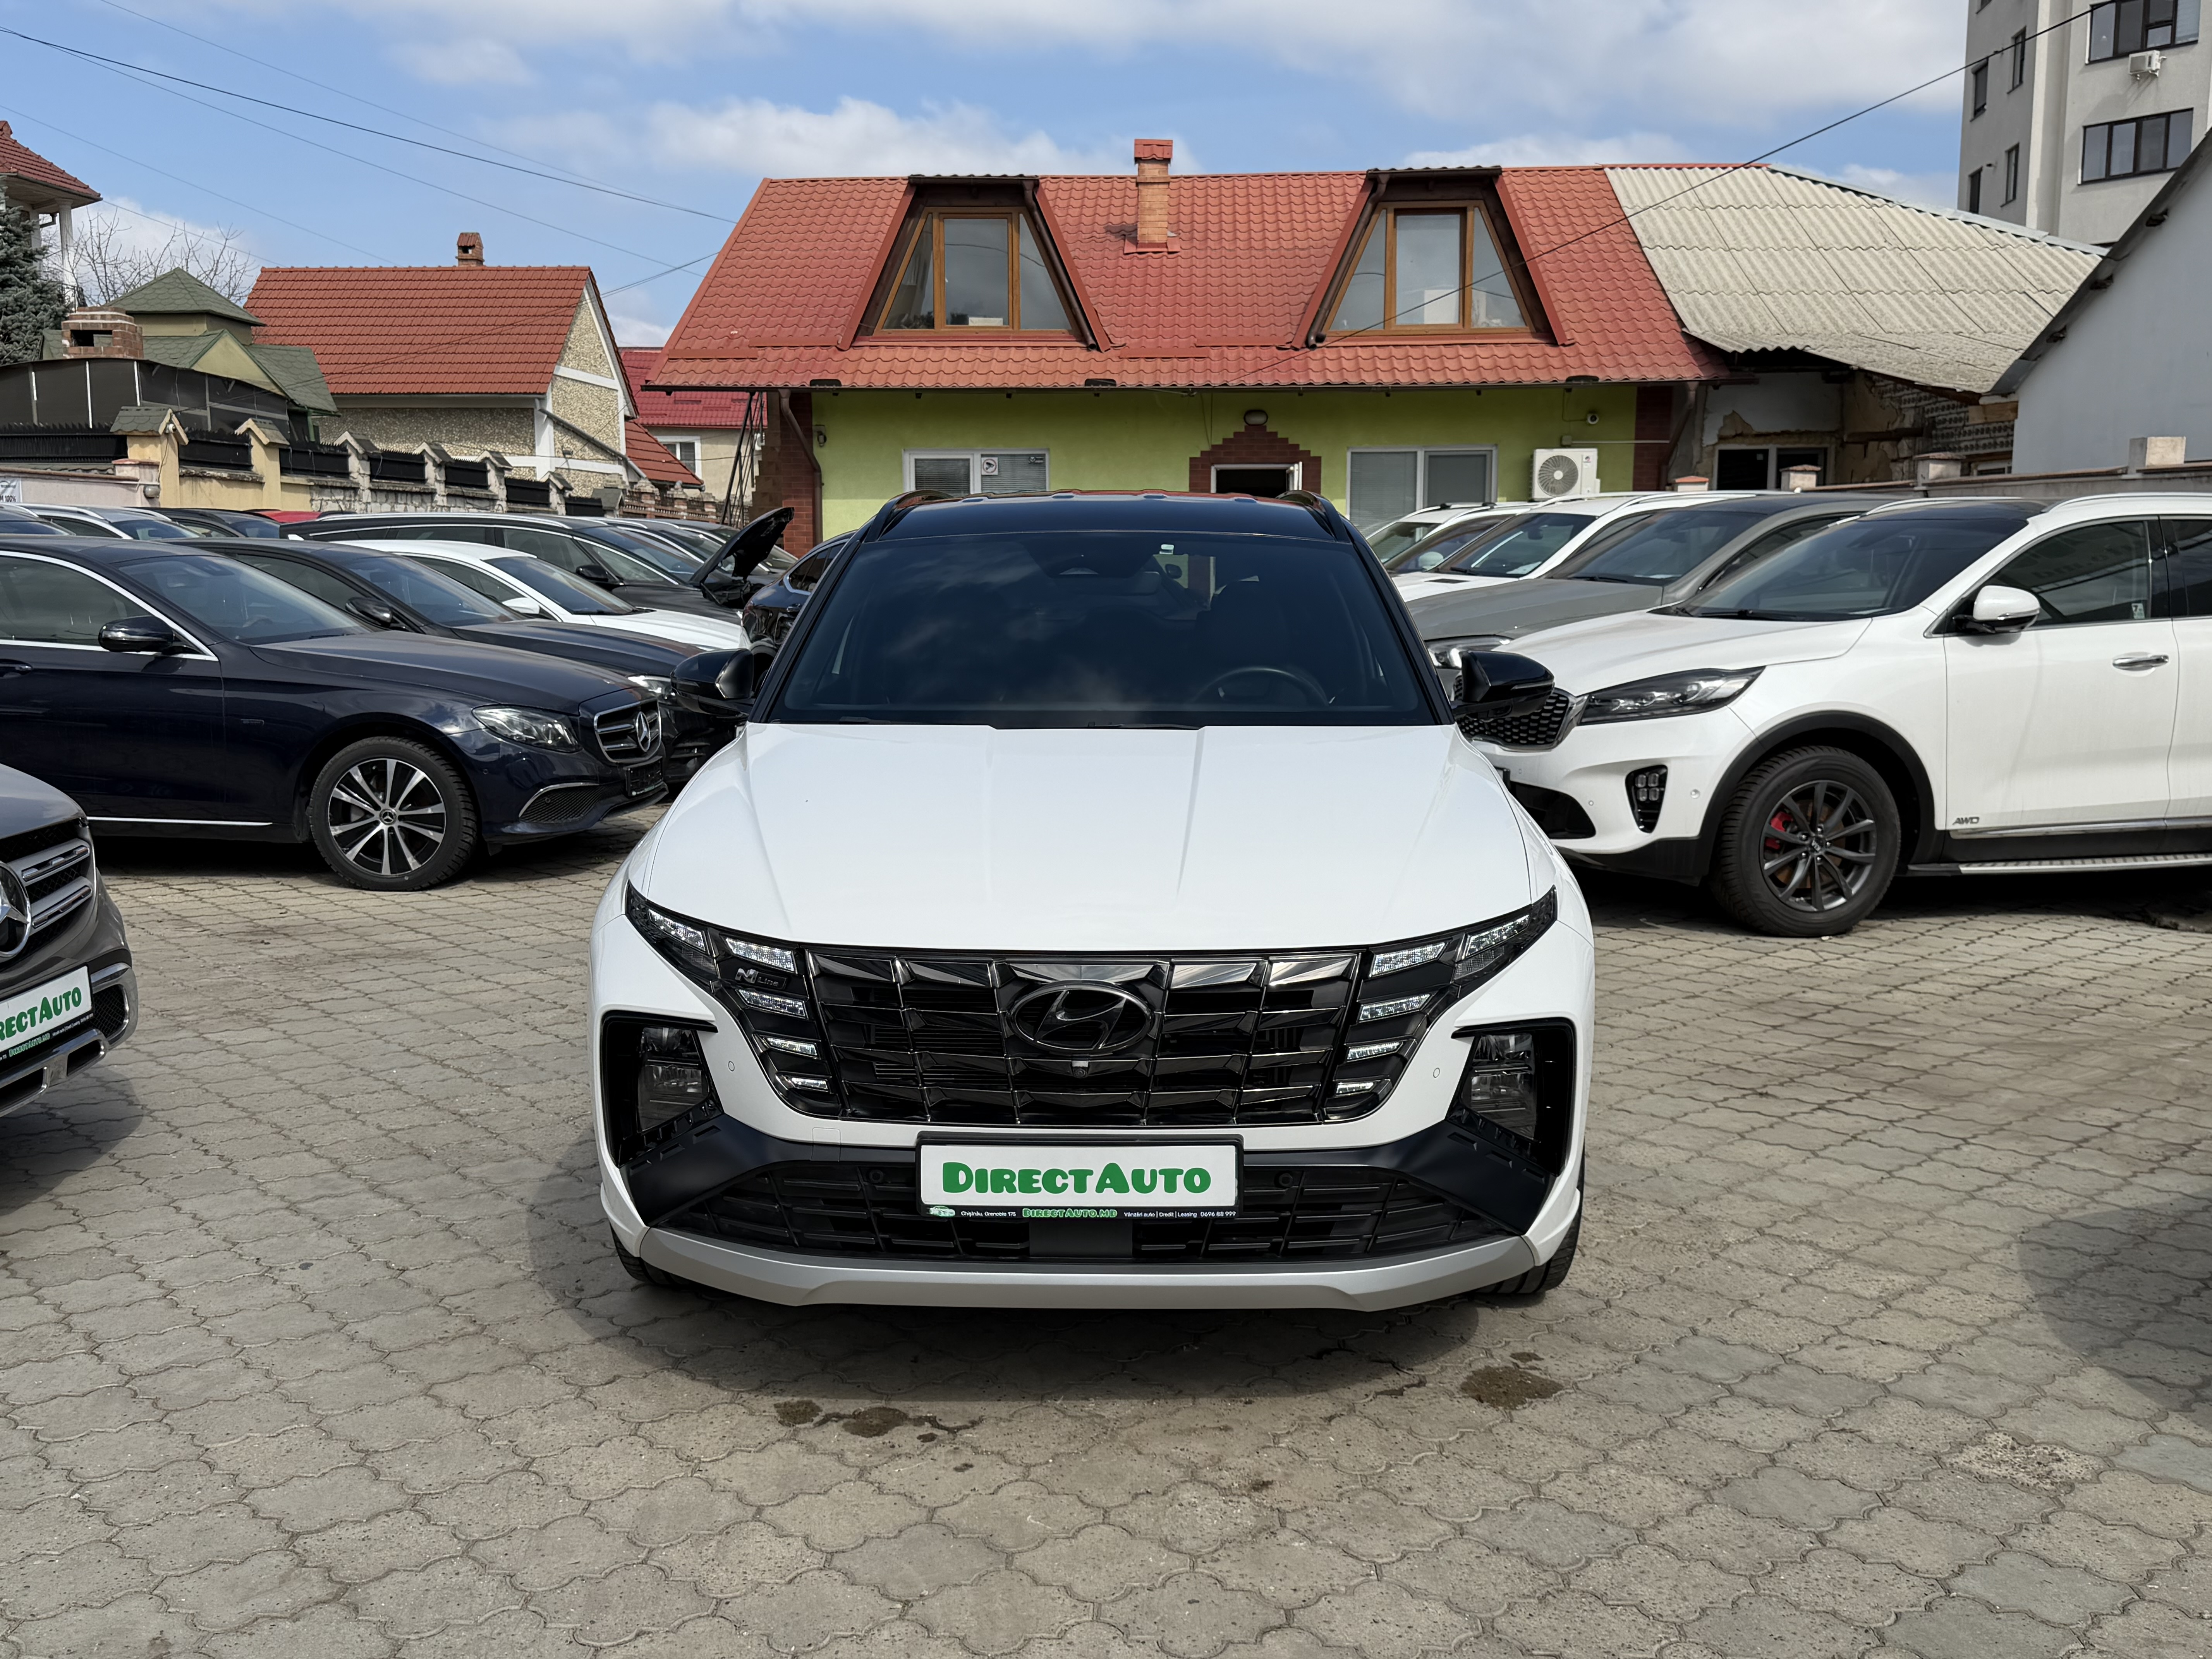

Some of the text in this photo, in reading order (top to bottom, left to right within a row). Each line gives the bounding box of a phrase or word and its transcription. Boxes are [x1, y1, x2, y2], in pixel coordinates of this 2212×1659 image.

[1952, 816, 1980, 825] AWD
[735, 968, 778, 987] N Line
